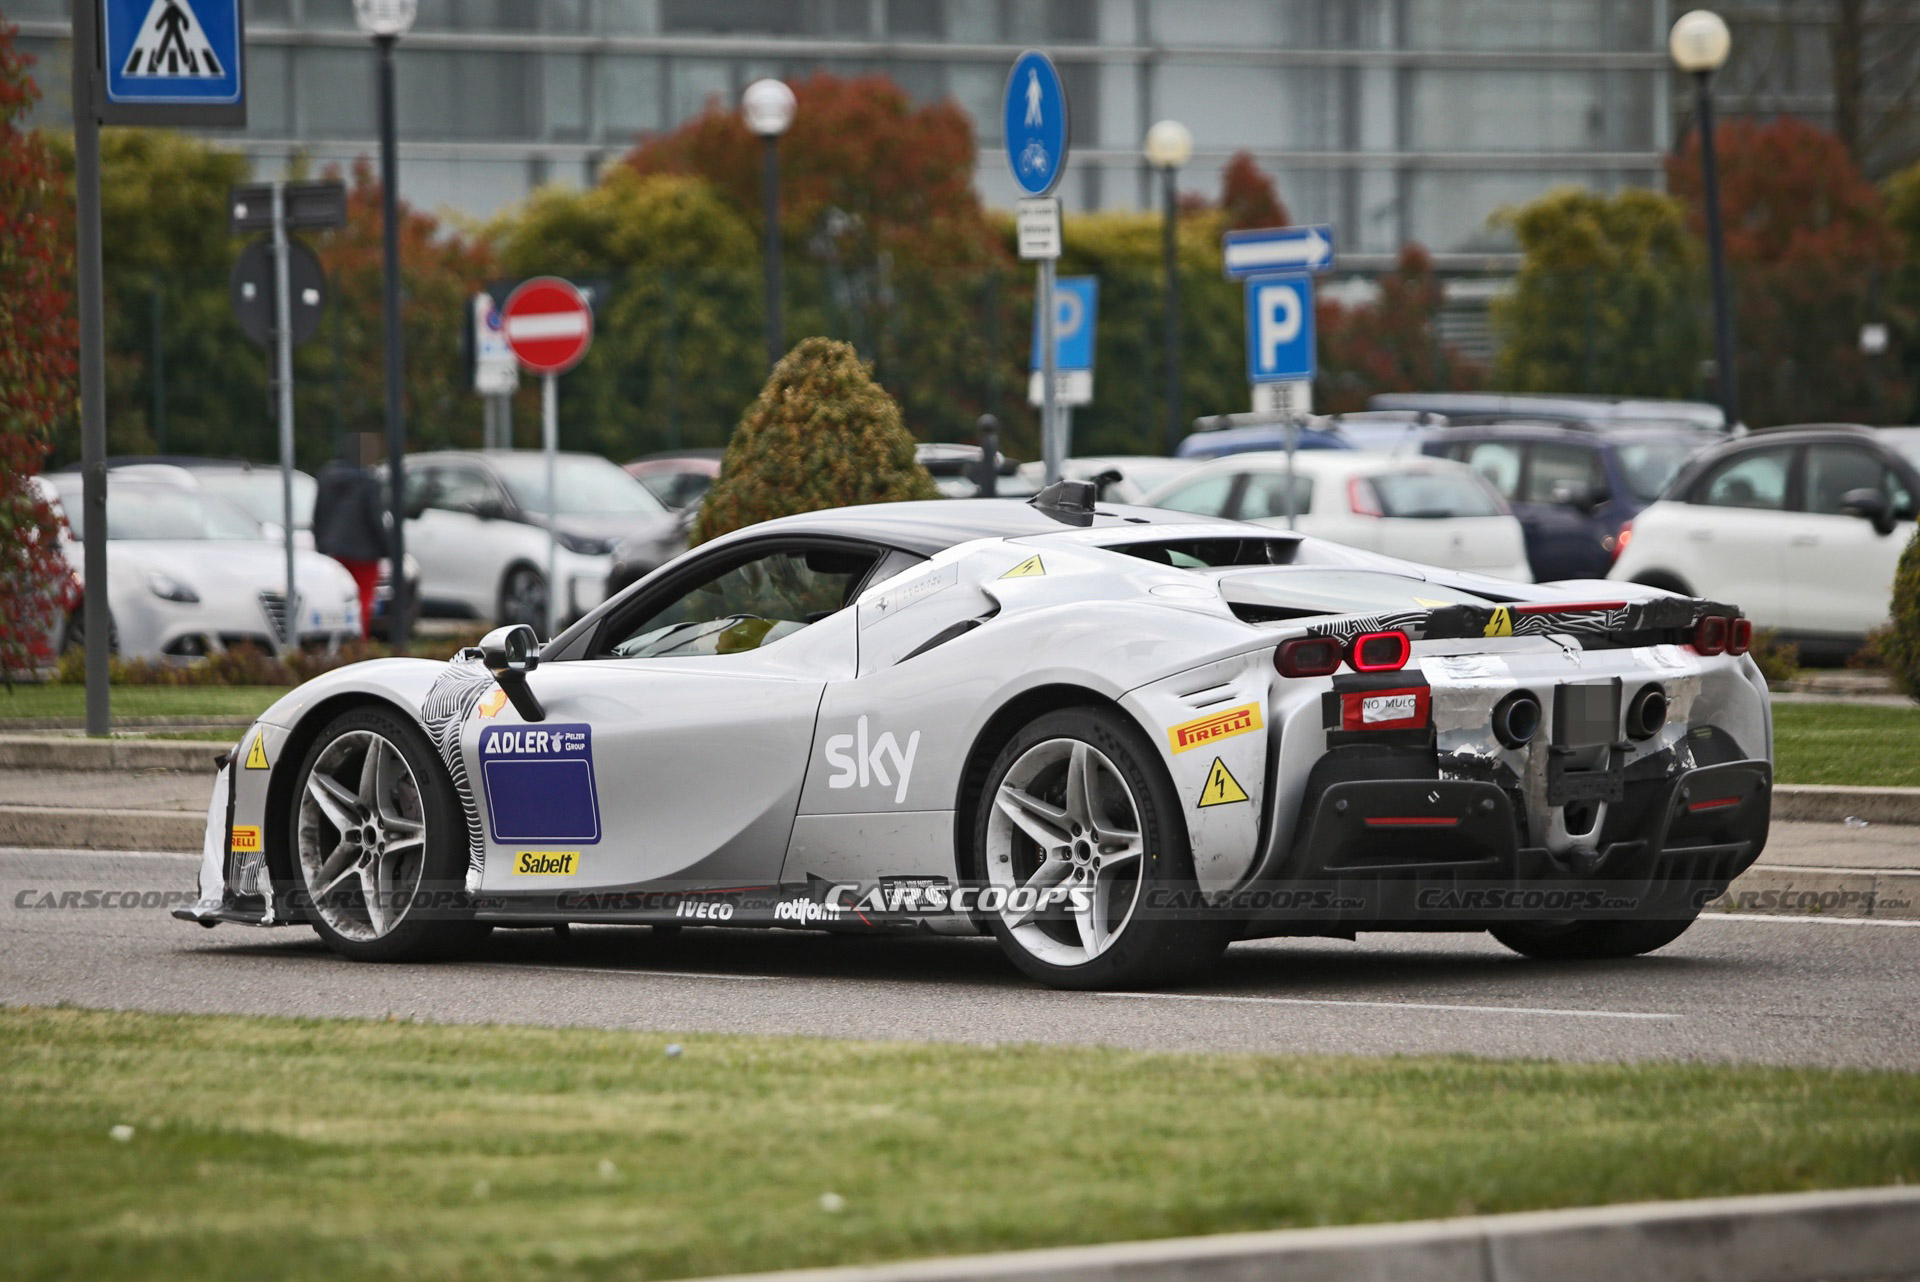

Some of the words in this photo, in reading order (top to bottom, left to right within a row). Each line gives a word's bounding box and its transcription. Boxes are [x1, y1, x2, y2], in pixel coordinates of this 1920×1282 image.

[1259, 284, 1303, 371] P
[1363, 700, 1380, 709] NO
[1177, 709, 1251, 747] PIRELLI
[485, 731, 549, 753] ADLER
[565, 742, 585, 751] GROUP
[825, 714, 920, 804] sky
[232, 830, 255, 847] RELLI
[520, 853, 572, 873] Sabelt
[676, 901, 733, 920] IVECO
[774, 898, 840, 925] rotiform
